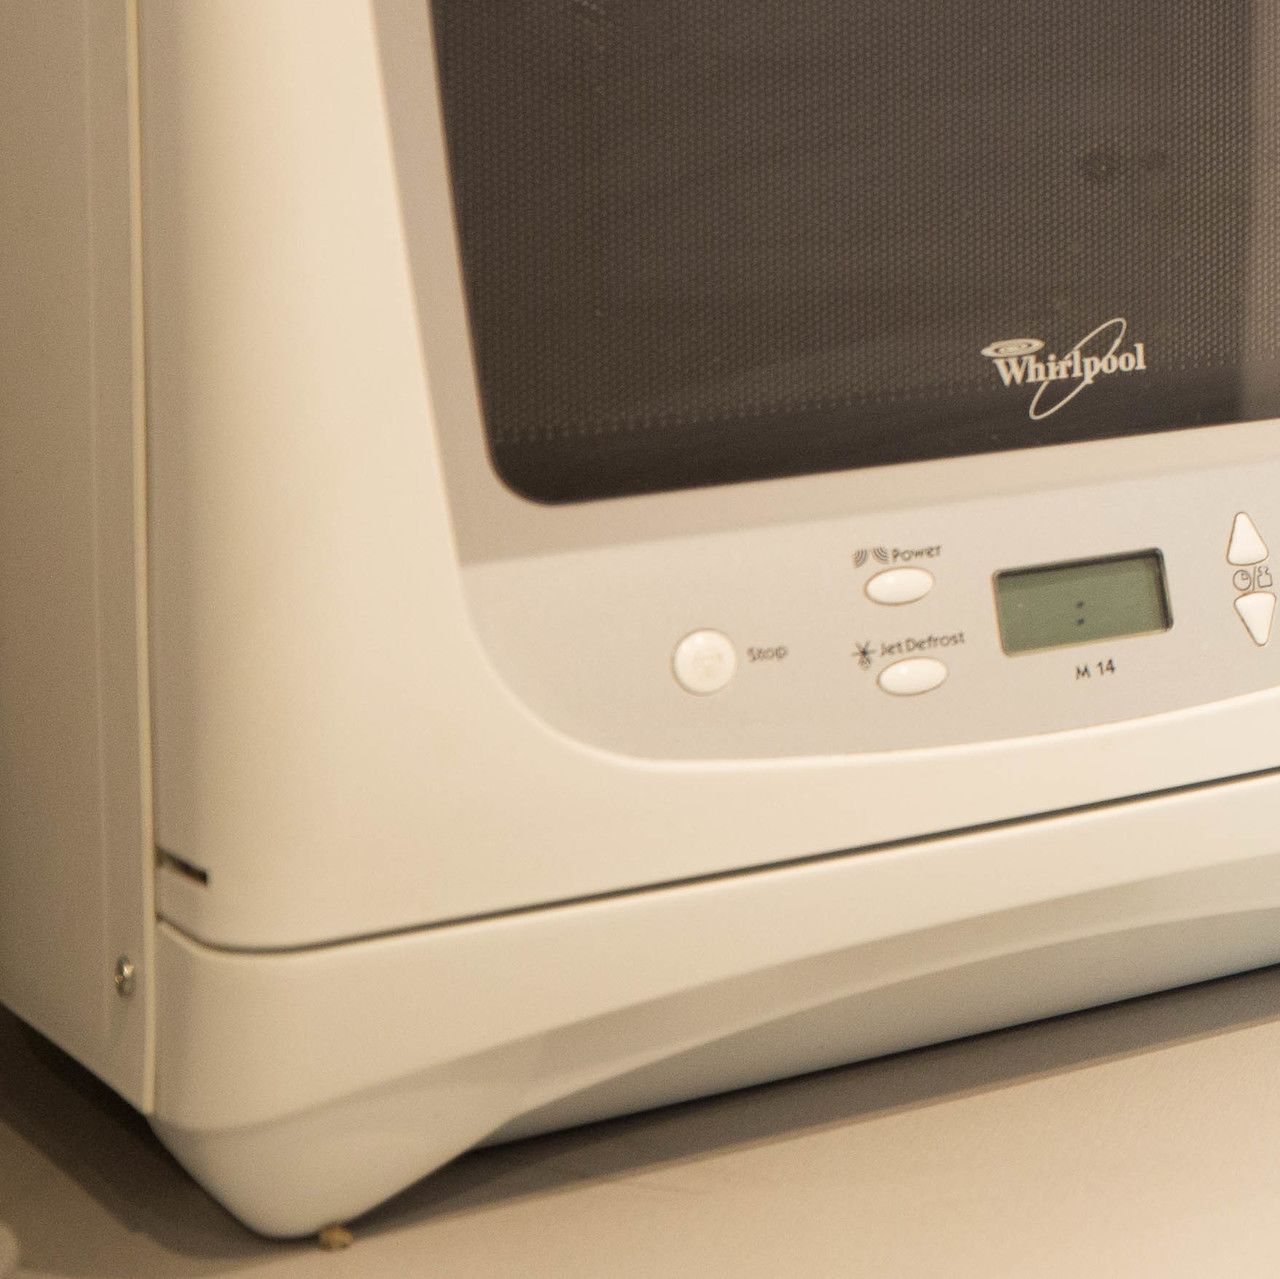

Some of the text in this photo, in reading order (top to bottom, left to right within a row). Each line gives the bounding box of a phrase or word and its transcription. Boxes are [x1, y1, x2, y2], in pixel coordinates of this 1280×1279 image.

[993, 342, 1147, 388] Whirlpool
[892, 544, 942, 562] Power
[880, 631, 965, 656] Jet Defrost
[1075, 658, 1116, 680] M 14
